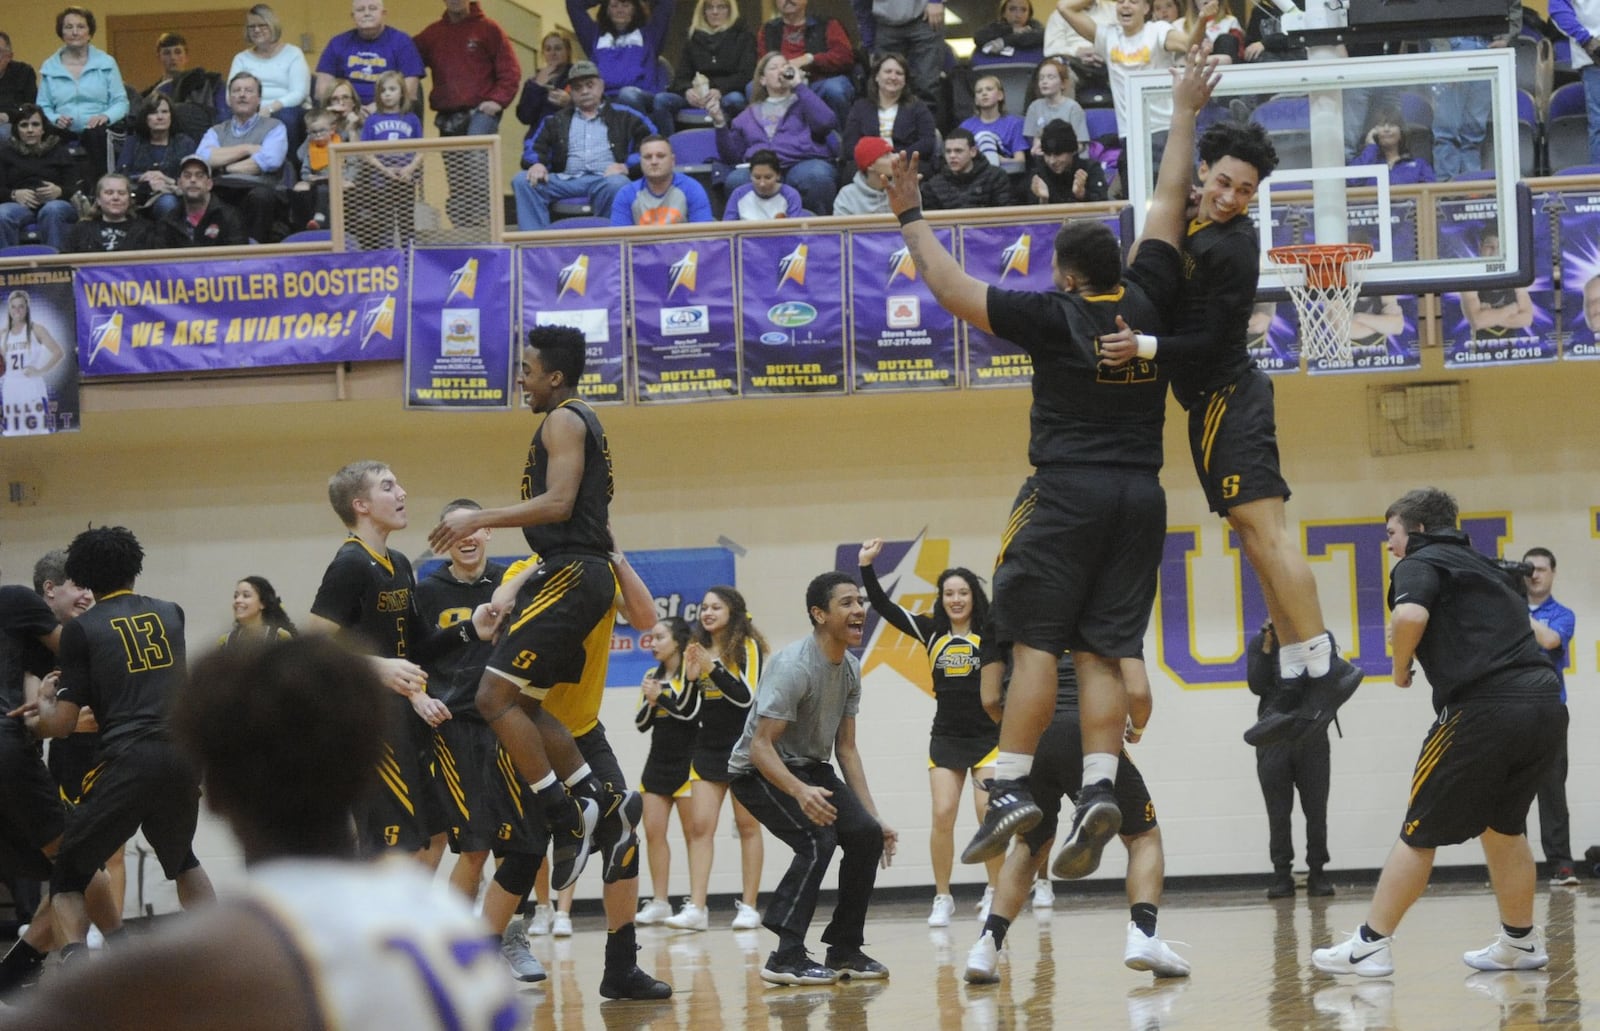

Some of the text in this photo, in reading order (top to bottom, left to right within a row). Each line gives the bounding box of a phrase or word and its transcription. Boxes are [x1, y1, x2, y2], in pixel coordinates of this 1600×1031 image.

[84, 265, 399, 308] VANDALIA-BUTLER BOOSTERS
[131, 309, 357, 348] WE ARE AVIATORS!
[1357, 356, 1371, 367] of
[1374, 354, 1405, 366] 2018
[1455, 347, 1542, 362] Class of 2018
[766, 363, 822, 375] BUTLER
[878, 358, 933, 371] BUTLER
[661, 368, 716, 382] BUTLER
[752, 374, 838, 387] WRESTLING
[863, 369, 949, 383] WRESTLING
[432, 377, 487, 388] BUTLER
[646, 379, 732, 393] WRESTLING
[416, 388, 503, 400] WRESTLING
[0, 401, 59, 415] ILLOW
[1222, 474, 1241, 499] S
[110, 612, 174, 673] 13
[512, 649, 537, 669] S
